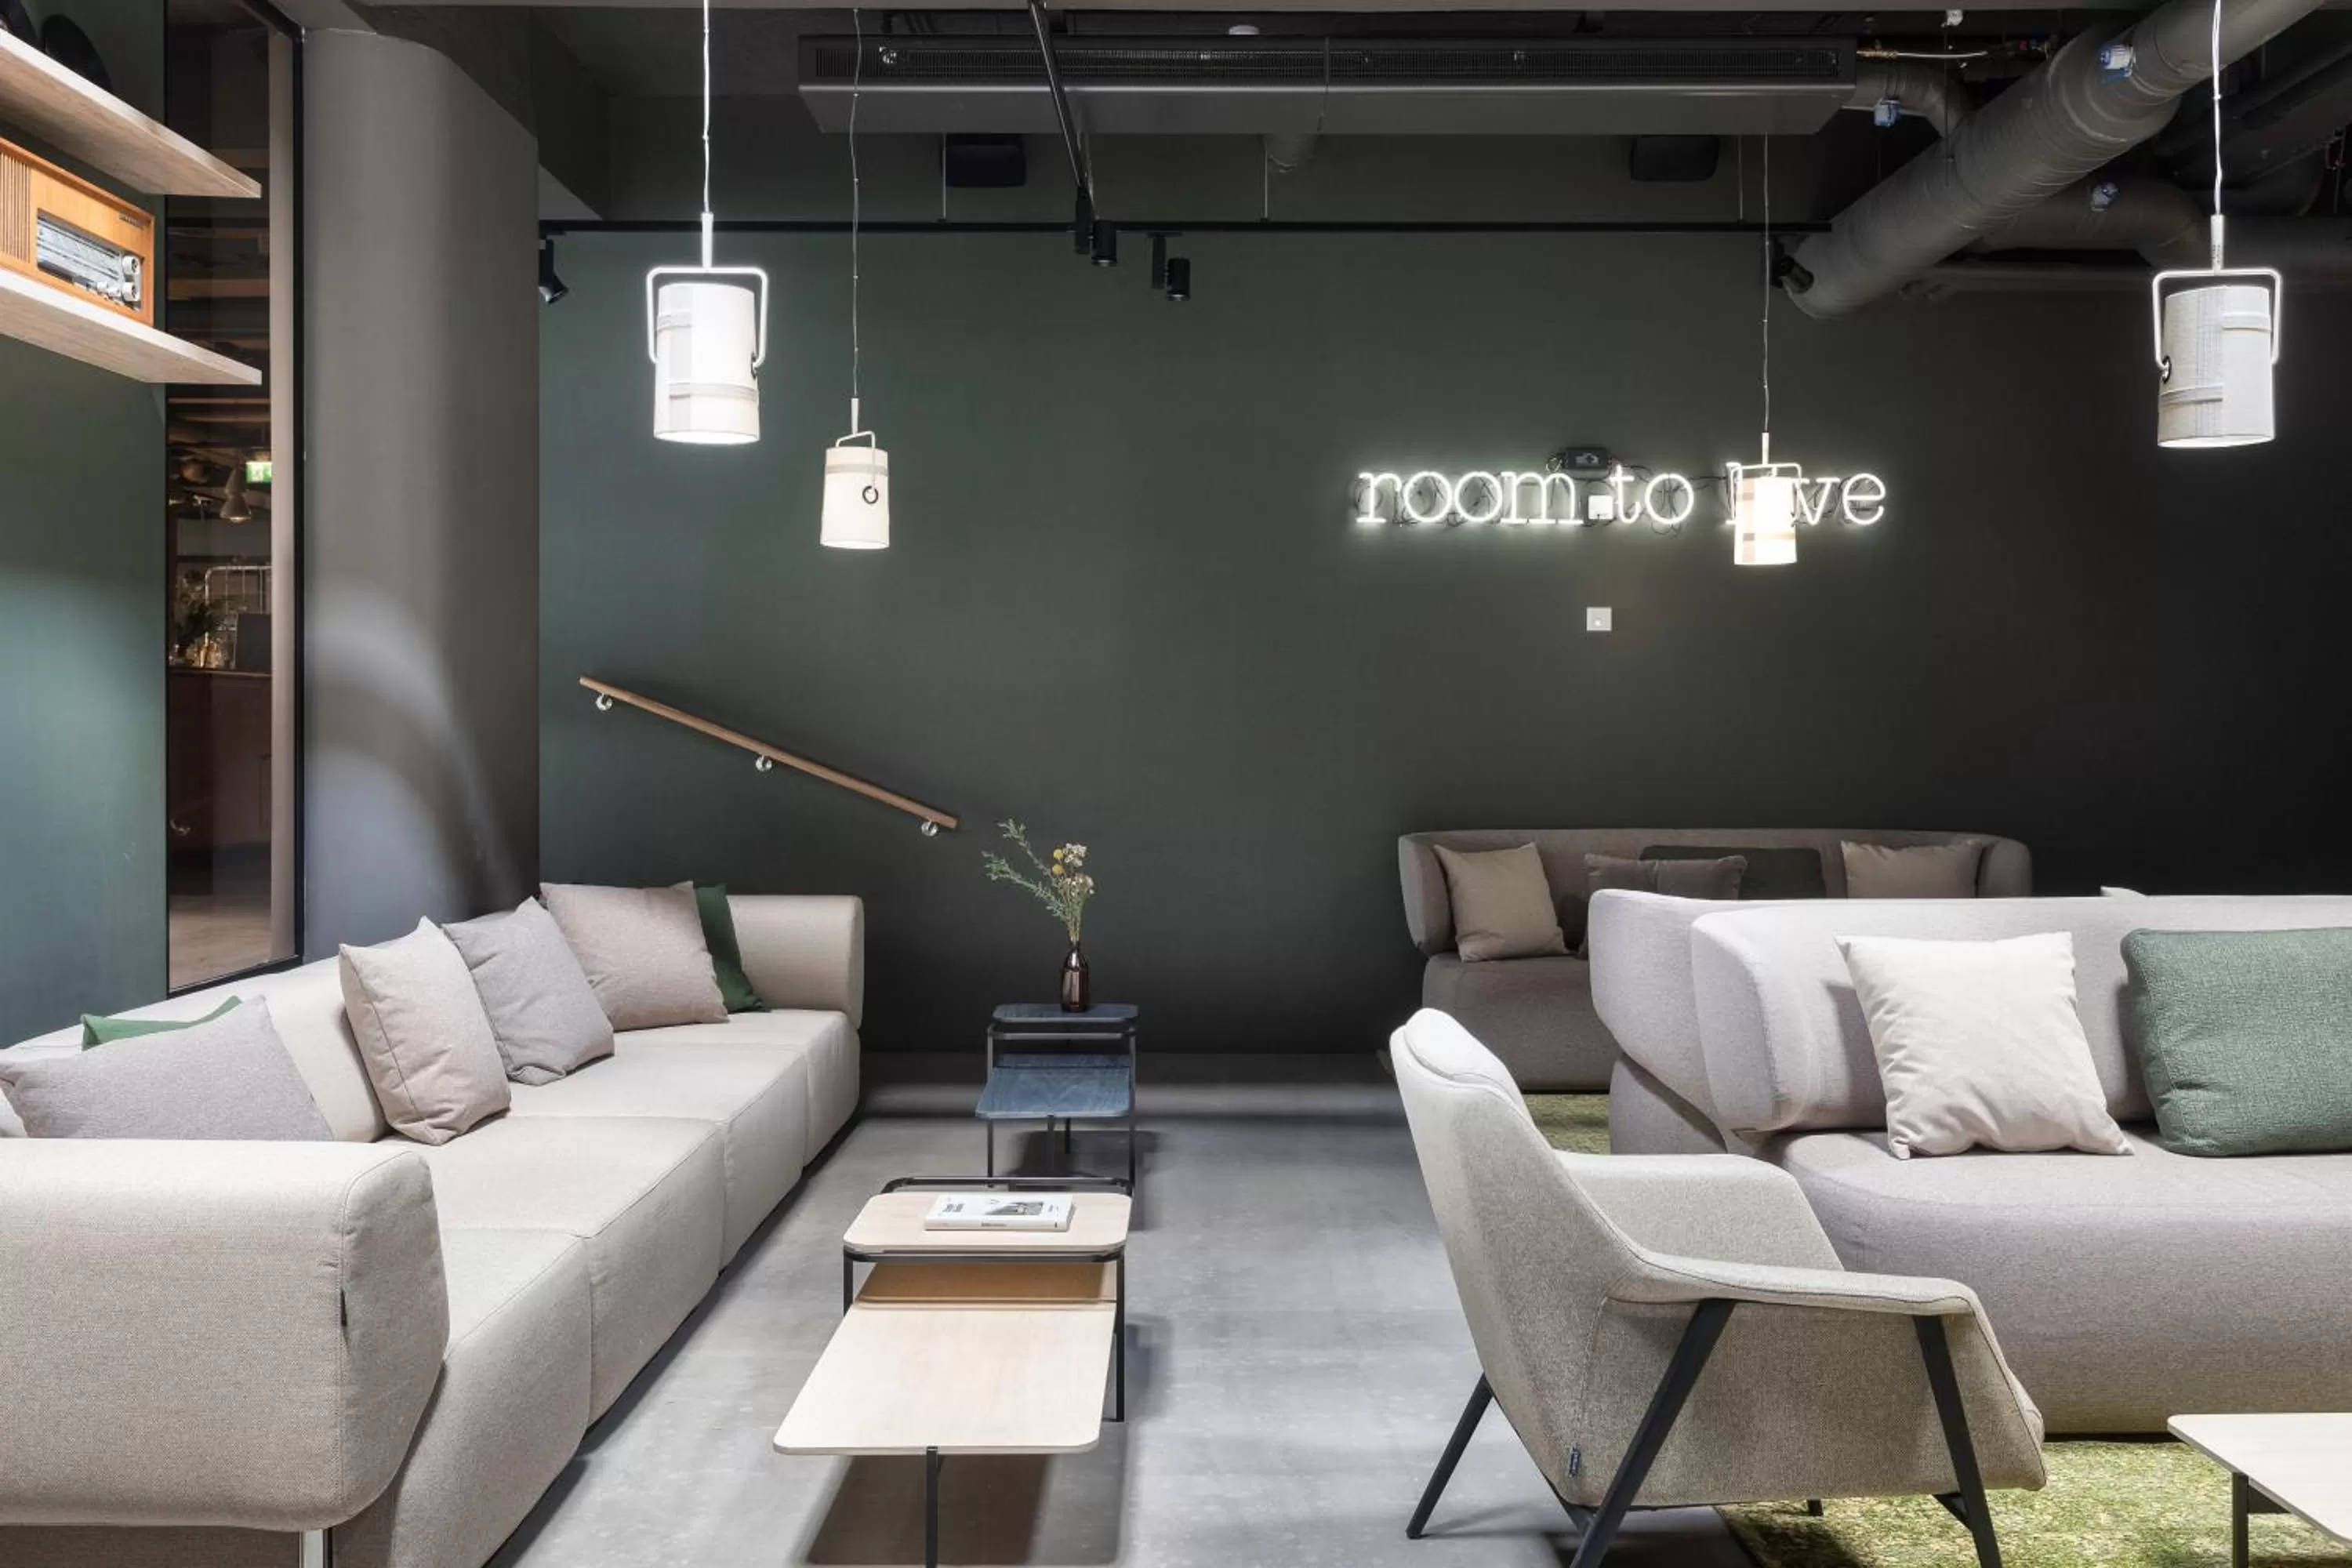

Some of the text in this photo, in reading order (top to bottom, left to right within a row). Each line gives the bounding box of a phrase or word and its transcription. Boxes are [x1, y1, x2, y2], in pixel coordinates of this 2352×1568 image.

[1356, 461, 1886, 526] room to lve
